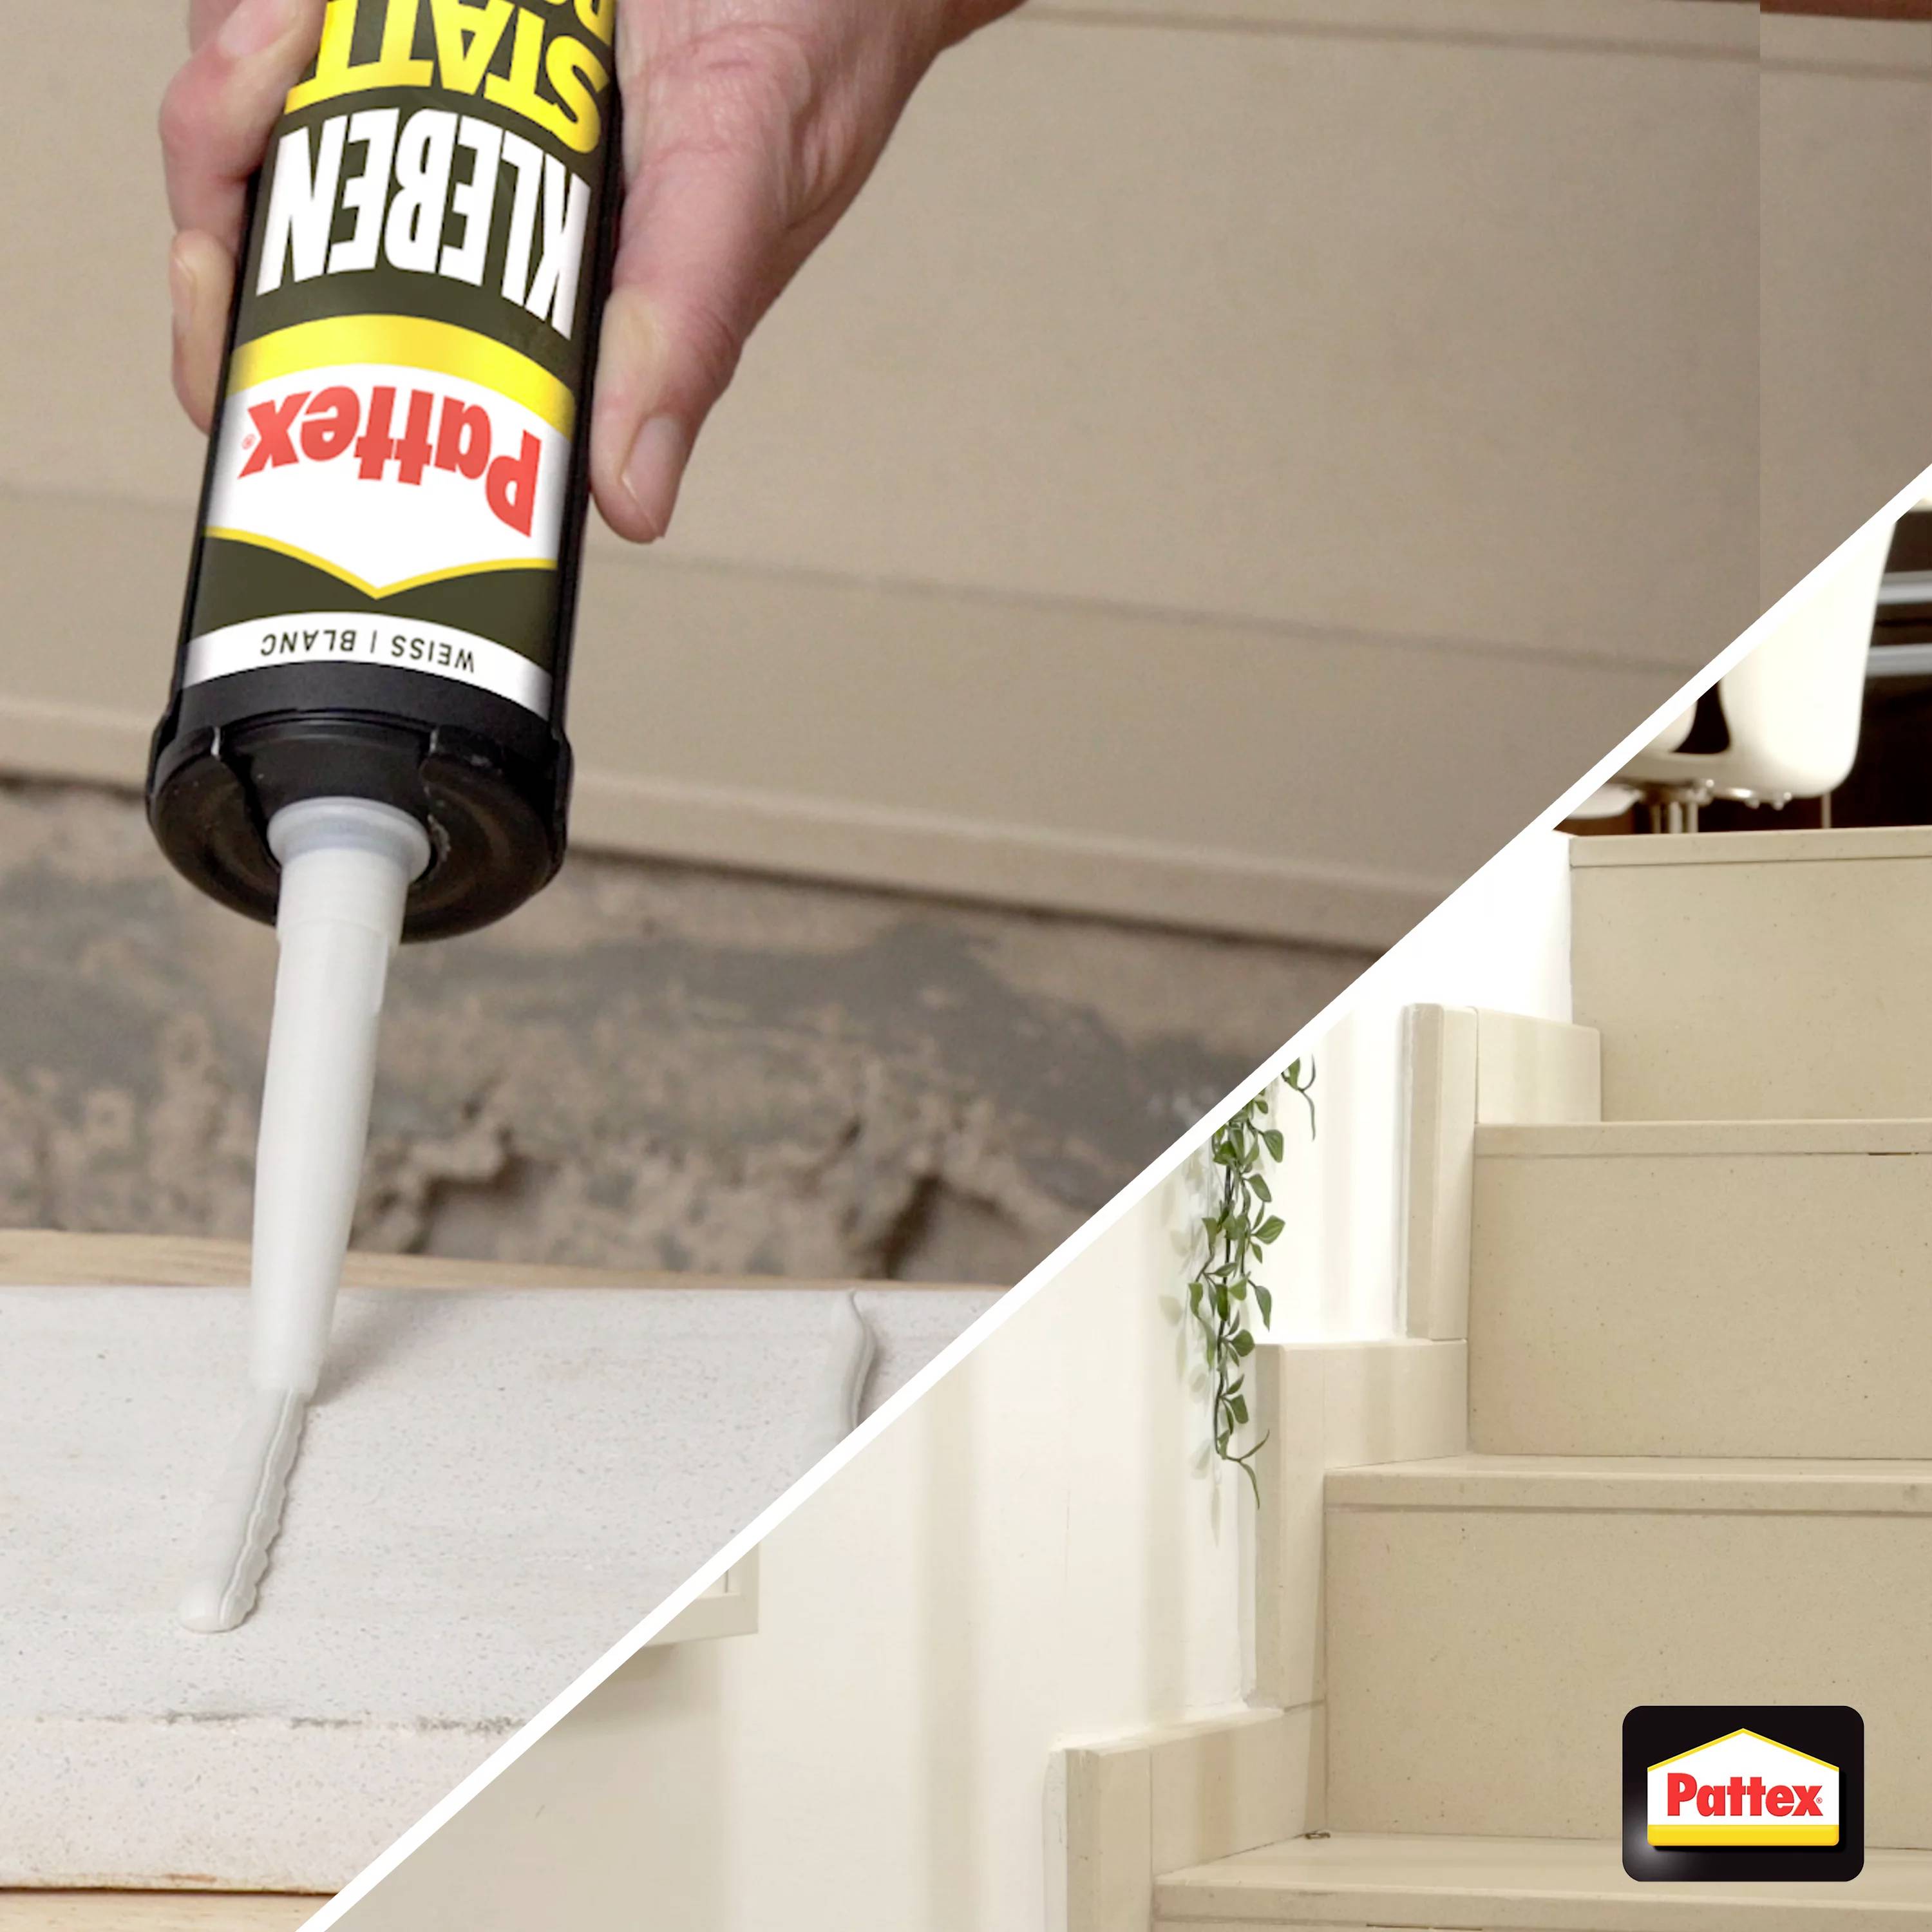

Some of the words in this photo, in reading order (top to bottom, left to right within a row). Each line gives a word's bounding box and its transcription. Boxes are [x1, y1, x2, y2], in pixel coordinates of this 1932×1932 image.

[284, 0, 610, 154] STATT
[256, 108, 591, 340] KLEBEN
[260, 629, 356, 657] BLANC
[391, 634, 475, 672] WEISS
